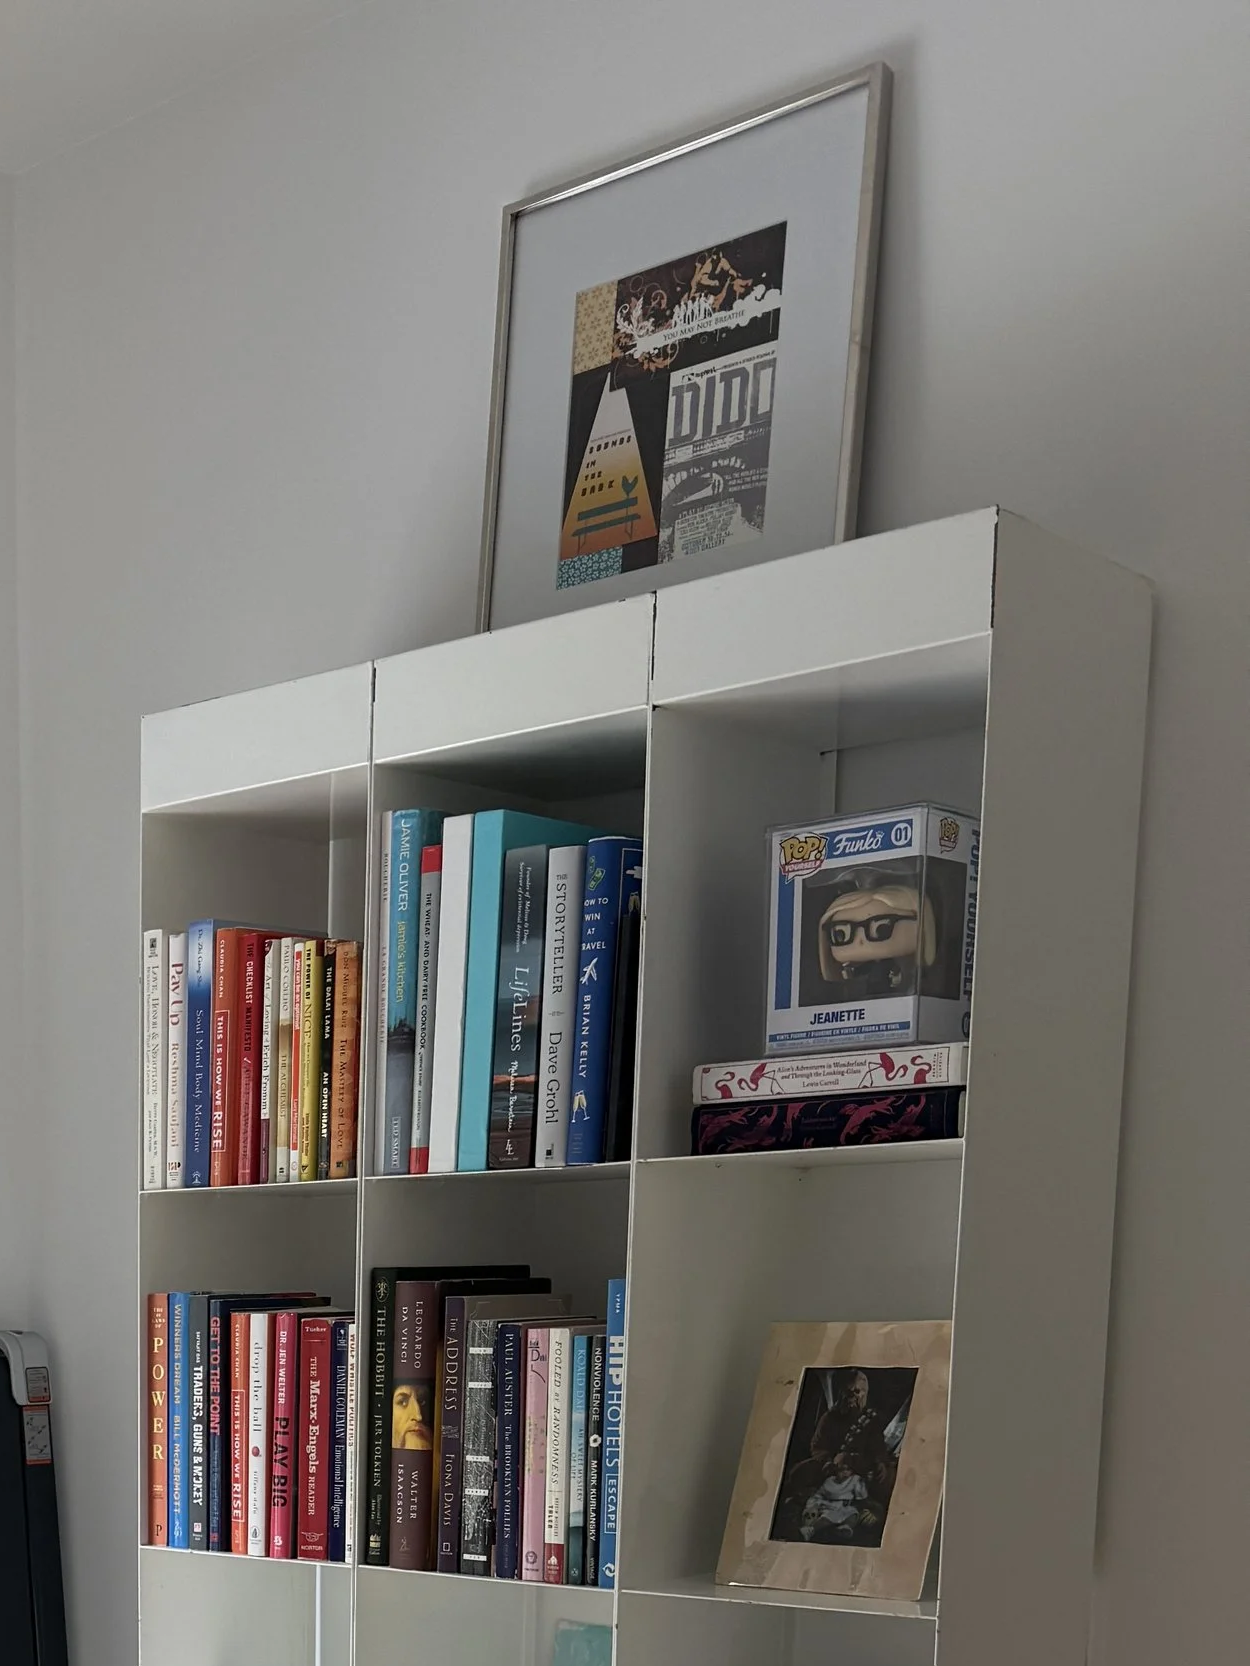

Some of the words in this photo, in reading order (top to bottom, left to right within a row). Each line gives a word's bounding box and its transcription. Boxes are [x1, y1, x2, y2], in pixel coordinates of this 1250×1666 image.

[663, 331, 680, 340] YOU
[680, 327, 695, 337] MAY
[697, 321, 712, 331] NOT
[715, 310, 745, 325] BREATHE
[399, 819, 411, 859] JAMIE
[779, 835, 828, 862] POP!
[833, 830, 884, 855] Funko
[897, 825, 909, 841] 01
[783, 860, 822, 874] YOURSELF
[398, 863, 409, 911] OLIVER
[584, 912, 601, 921] WIN
[587, 927, 595, 935] AT
[552, 883, 567, 995] STORYTELLER
[195, 1010, 204, 1034] Soul
[216, 1016, 224, 1039] THIS
[510, 967, 529, 1051] LifeLines
[582, 995, 591, 1035] BRIAN
[810, 1009, 865, 1025] JEANETTE
[195, 1039, 203, 1068] Mind
[216, 1044, 223, 1054] IS
[548, 1032, 562, 1073] Dave
[578, 1041, 589, 1078] KELLY
[193, 1073, 203, 1098] Body
[215, 1058, 223, 1085] HOW
[803, 1080, 819, 1088] Lewis
[215, 1091, 222, 1106] WE
[545, 1079, 560, 1123] Grohl
[194, 1104, 202, 1152] Medicine
[213, 1111, 223, 1148] RISE
[211, 1317, 219, 1343] GET
[376, 1307, 386, 1336] THE
[414, 1301, 423, 1368] LEONARDO
[211, 1348, 219, 1364] TO
[505, 1334, 514, 1364] PAUL
[610, 1336, 624, 1385] HIP
[211, 1368, 219, 1393] THE
[278, 1368, 286, 1404] WELTER
[375, 1341, 385, 1398] HOBBIT
[592, 1348, 601, 1421] NONVIOLENCE
[152, 1337, 166, 1460] POWER
[504, 1368, 513, 1415] AUSTER
[211, 1396, 219, 1435] POINT
[606, 1391, 621, 1467] HOTELS
[274, 1417, 290, 1468] PLAY
[335, 1445, 344, 1482] Emotional
[445, 1454, 455, 1487] FIONA
[504, 1445, 512, 1496] BROOKLYN
[273, 1475, 288, 1507] BIG
[331, 1484, 343, 1528] Intelligence
[410, 1471, 418, 1519] WALTER
[443, 1493, 454, 1525] DAVIS
[607, 1480, 617, 1528] ESCAPE
[589, 1488, 597, 1541] KURLANSKY
